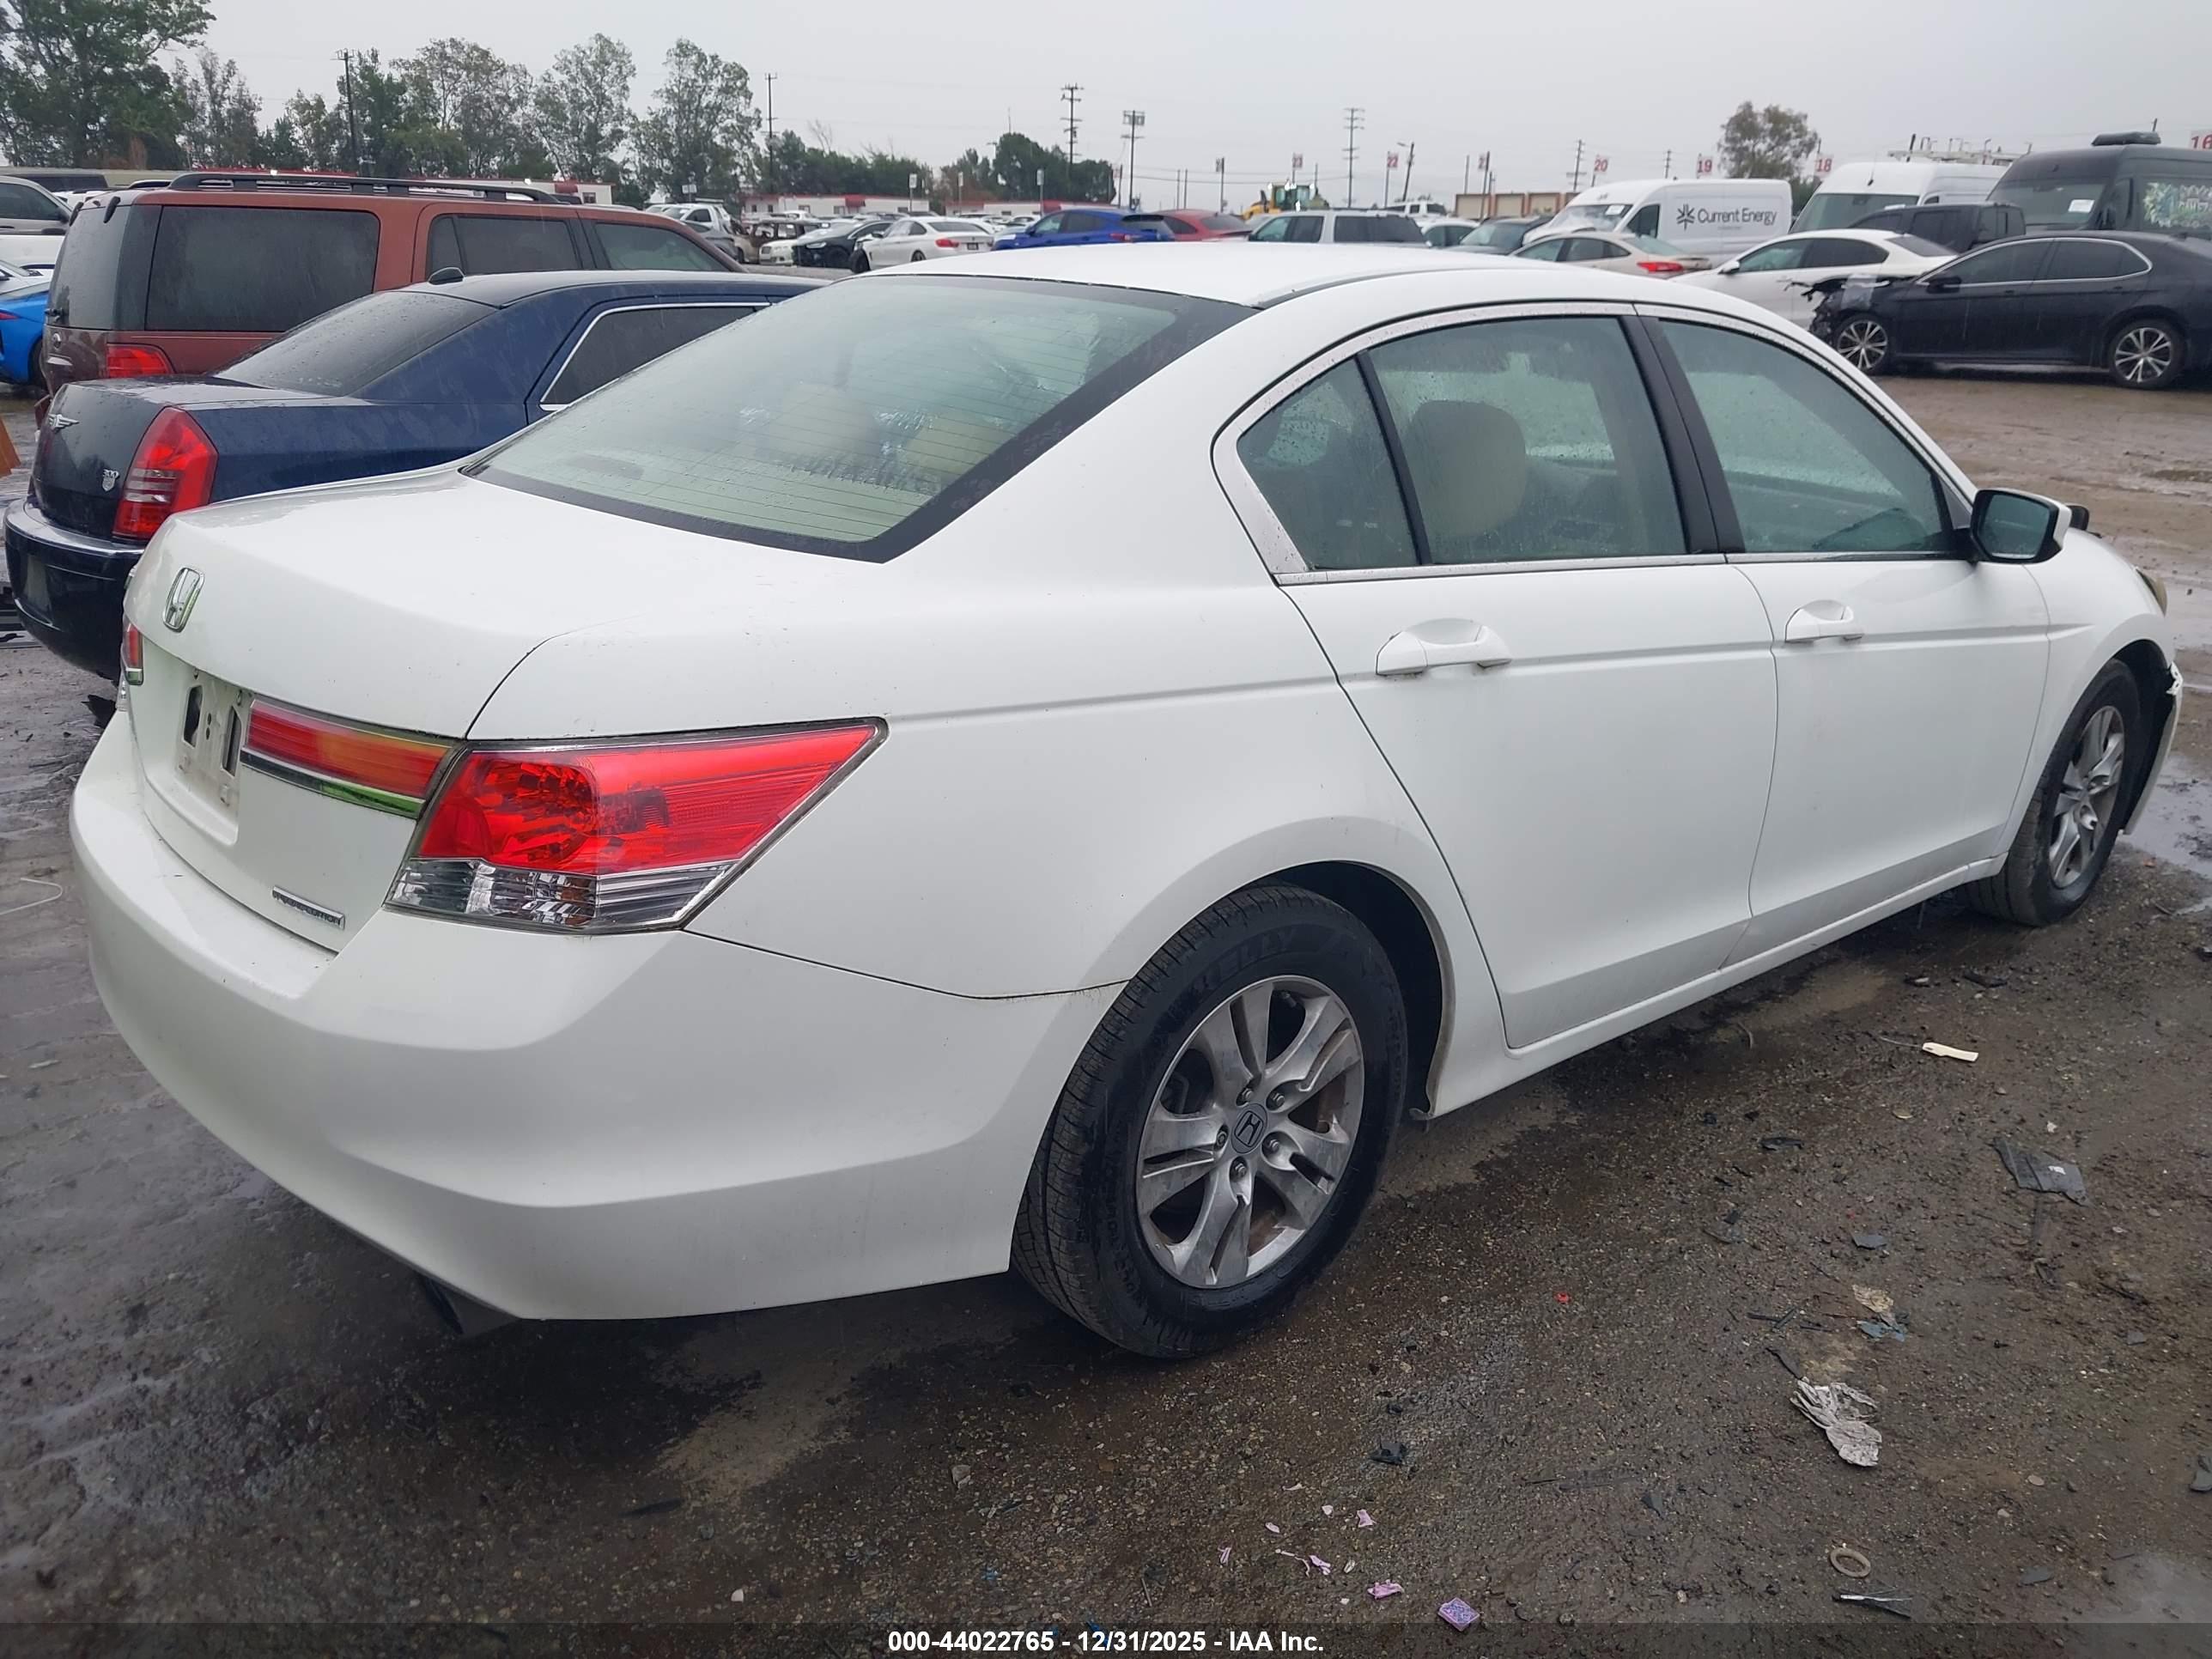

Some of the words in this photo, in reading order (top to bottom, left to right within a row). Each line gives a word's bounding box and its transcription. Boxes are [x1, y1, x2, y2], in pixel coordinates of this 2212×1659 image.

[1594, 158, 1608, 173] 20
[1697, 159, 1712, 173] 19
[1815, 158, 1832, 173] 18
[1698, 208, 1740, 223] Current
[1741, 208, 1778, 225] Energy
